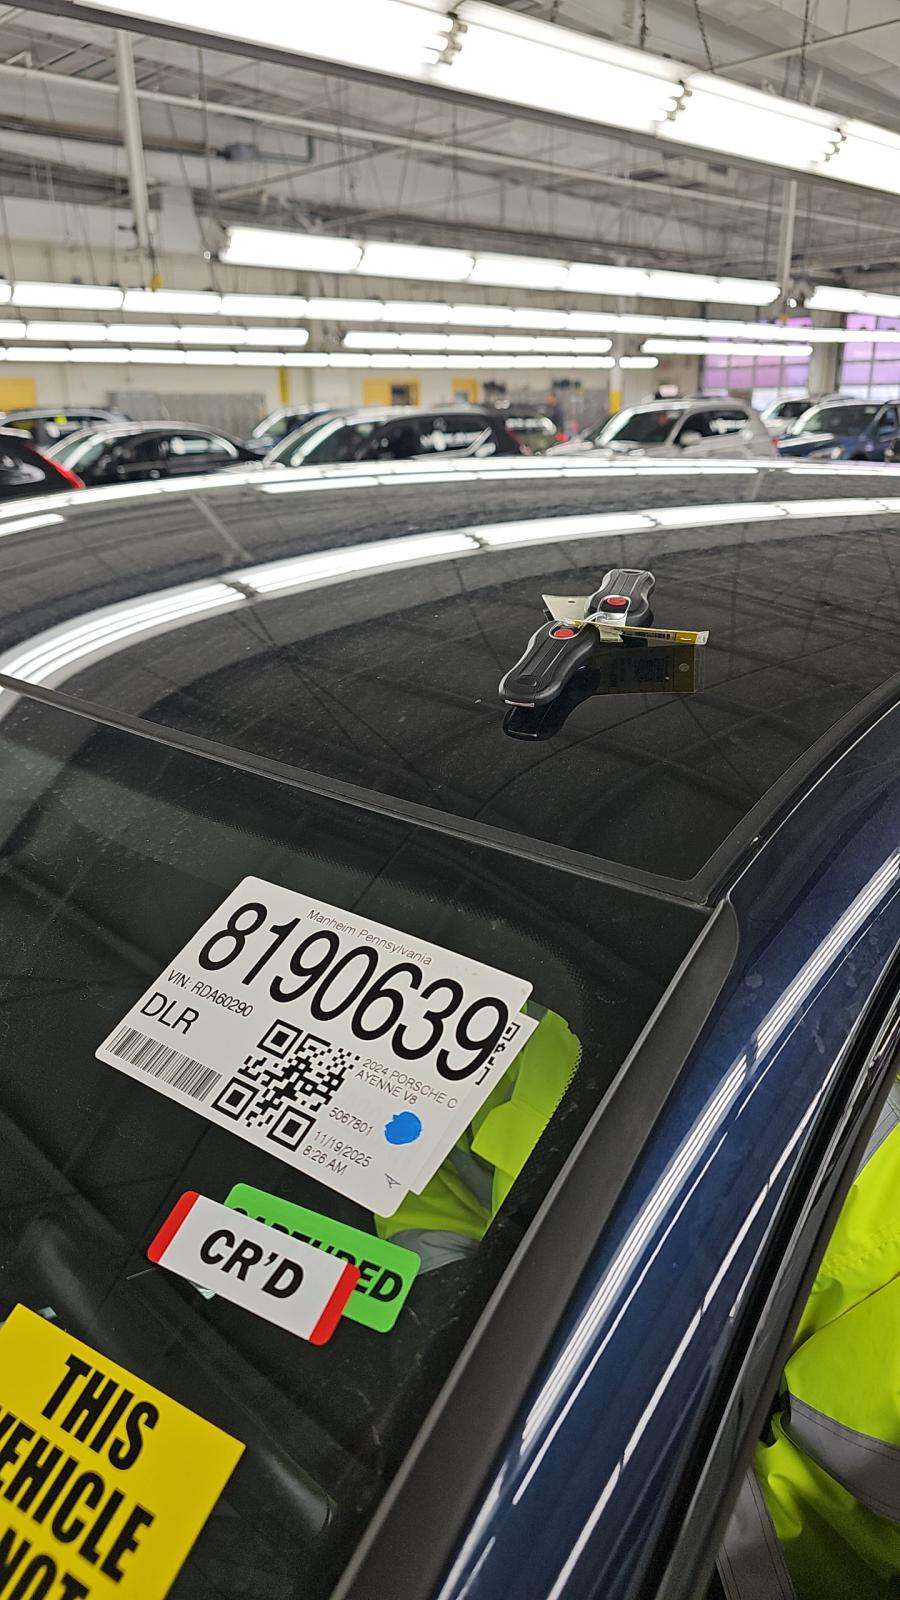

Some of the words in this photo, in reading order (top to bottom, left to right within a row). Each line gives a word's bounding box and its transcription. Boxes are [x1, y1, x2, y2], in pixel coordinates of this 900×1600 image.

[307, 909, 356, 936] Manheim
[358, 929, 432, 966] Pennsylvania
[140, 992, 200, 1034] DLR
[168, 969, 191, 989] VIN:
[191, 981, 254, 1017] RDA60290
[198, 902, 509, 1081] 8190639
[355, 1069, 403, 1097] AYENNE
[403, 1091, 418, 1105] V8
[362, 1058, 389, 1076] 2024
[389, 1070, 447, 1104] PORSCHE
[447, 1098, 458, 1109] C
[329, 1107, 374, 1135] 5067801
[303, 1145, 328, 1164] 8:26
[325, 1158, 348, 1176] AM
[313, 1131, 373, 1168] 11/19/2025
[199, 1229, 304, 1299] CR'D
[41, 1353, 159, 1471] THIS
